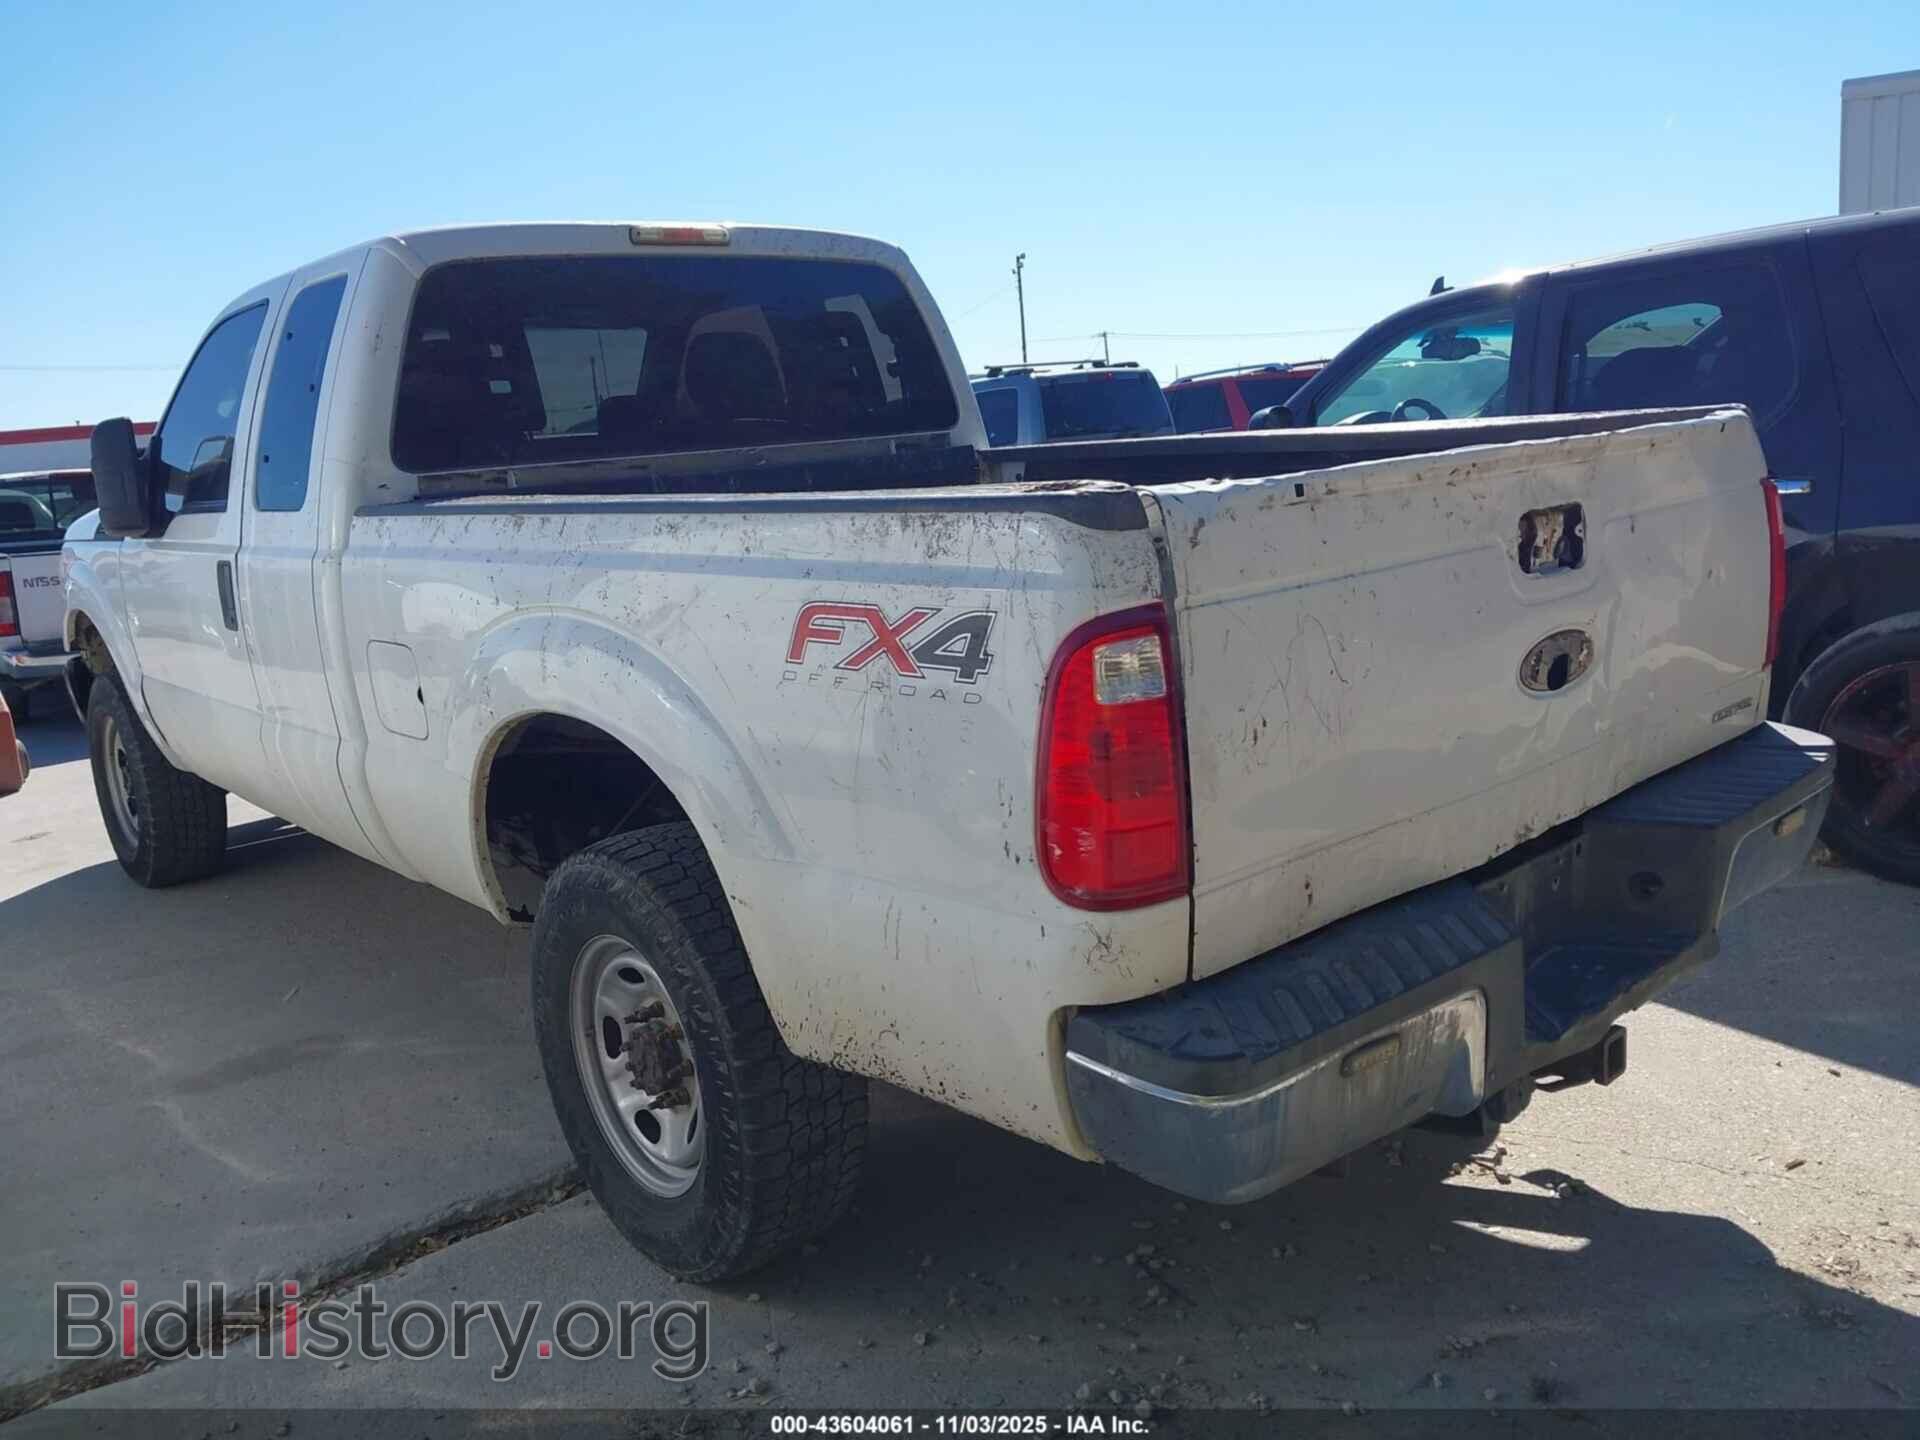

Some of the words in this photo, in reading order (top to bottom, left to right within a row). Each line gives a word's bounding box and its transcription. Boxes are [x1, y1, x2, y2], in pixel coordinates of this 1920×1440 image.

[23, 575, 61, 588] NISS
[785, 600, 998, 685] FX4
[782, 670, 849, 689] OFF
[870, 680, 983, 705] ROAD
